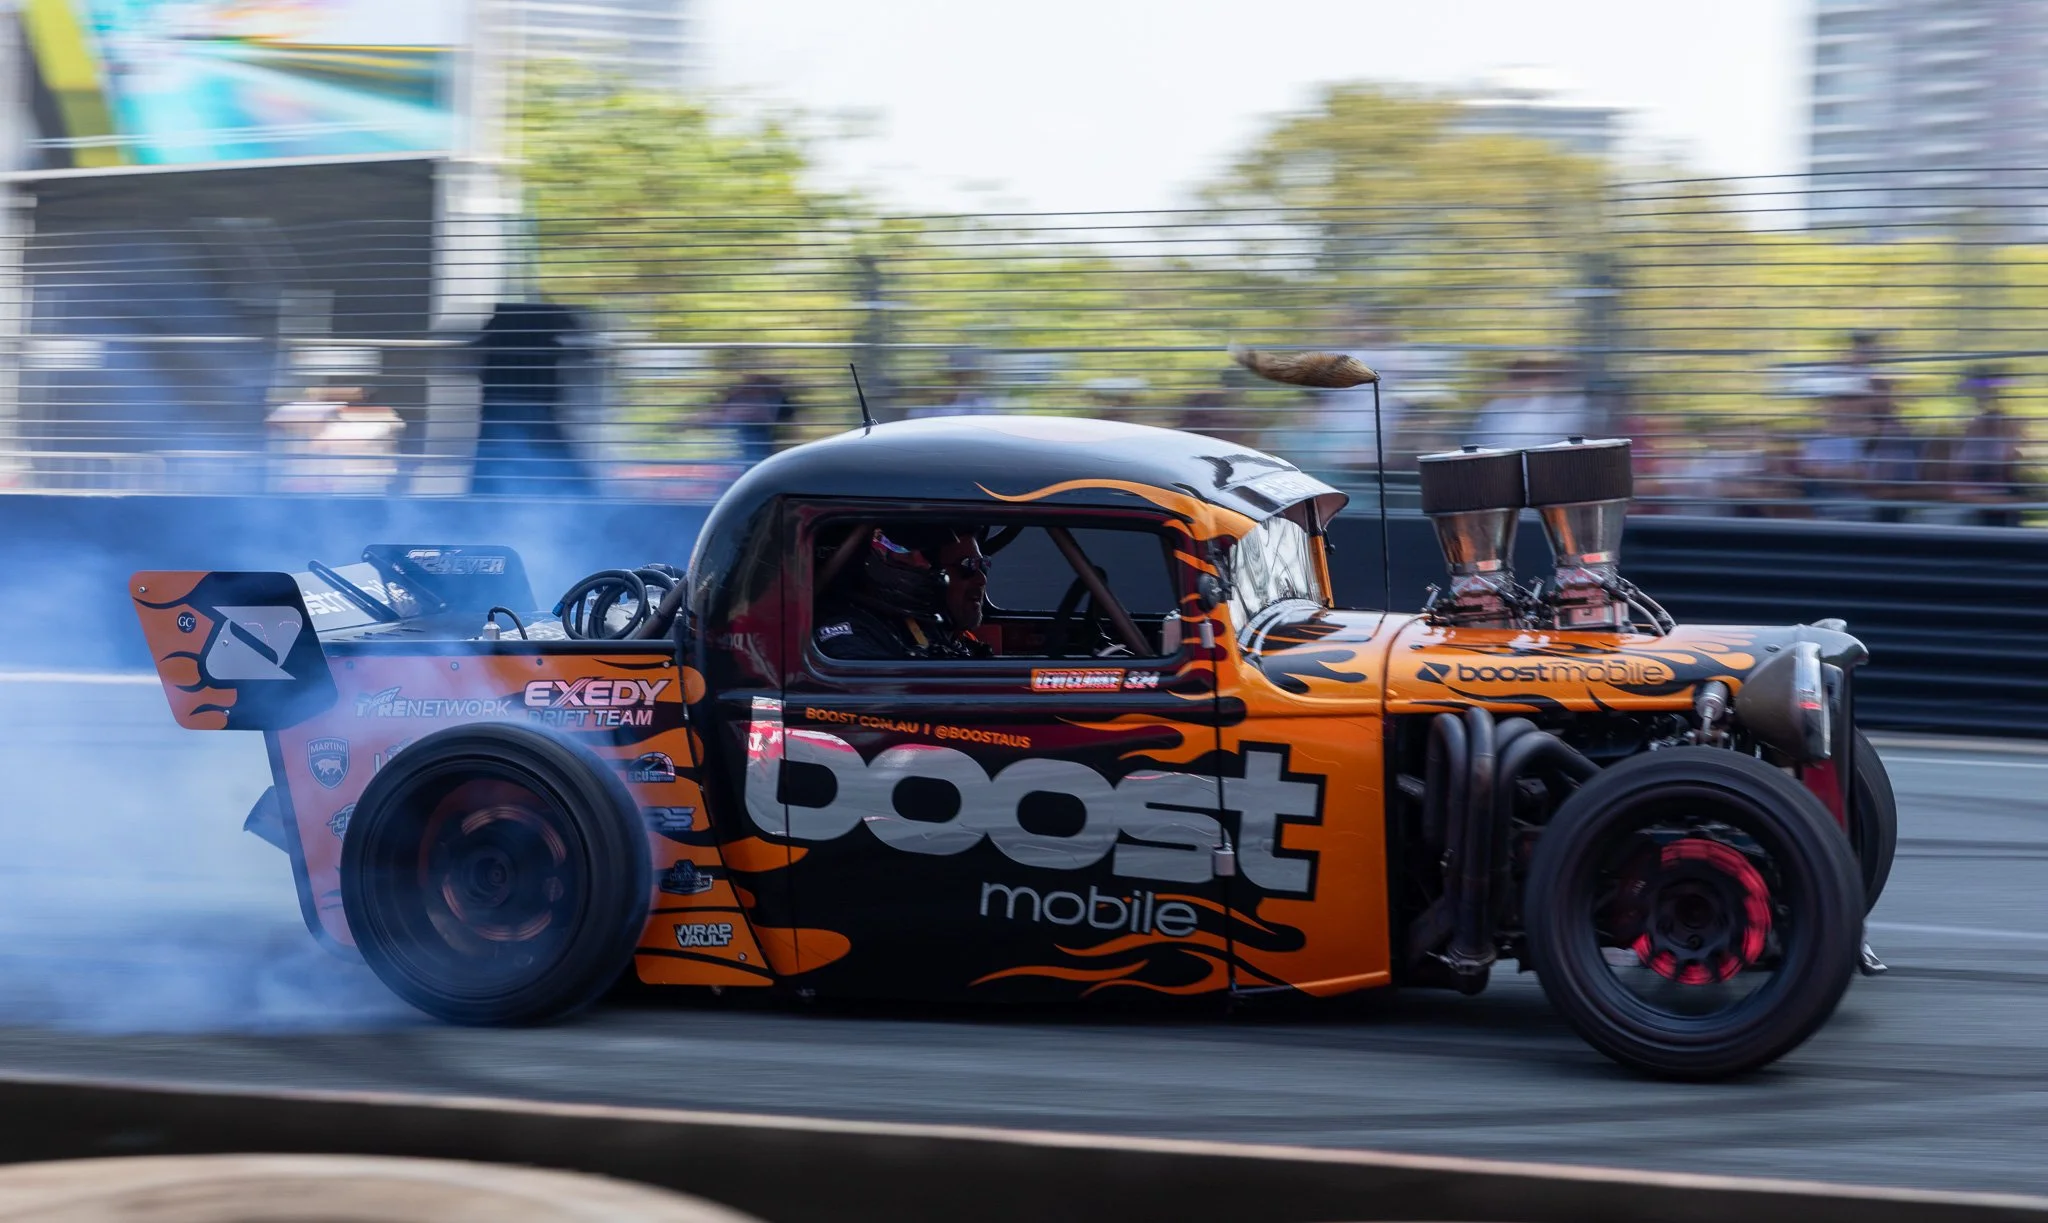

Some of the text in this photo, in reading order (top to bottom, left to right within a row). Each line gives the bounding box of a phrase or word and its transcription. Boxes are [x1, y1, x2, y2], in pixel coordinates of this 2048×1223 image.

[1458, 661, 1667, 686] boostmobile
[525, 678, 671, 707] EXEDY
[528, 709, 653, 727] DRIFT TEAM
[310, 741, 346, 754] MARTINI
[934, 725, 1031, 749] @BOOSTAUS
[744, 695, 1319, 894] boost
[979, 881, 1199, 937] mobile
[676, 923, 732, 936] WRAP
[676, 934, 732, 946] VAULT
